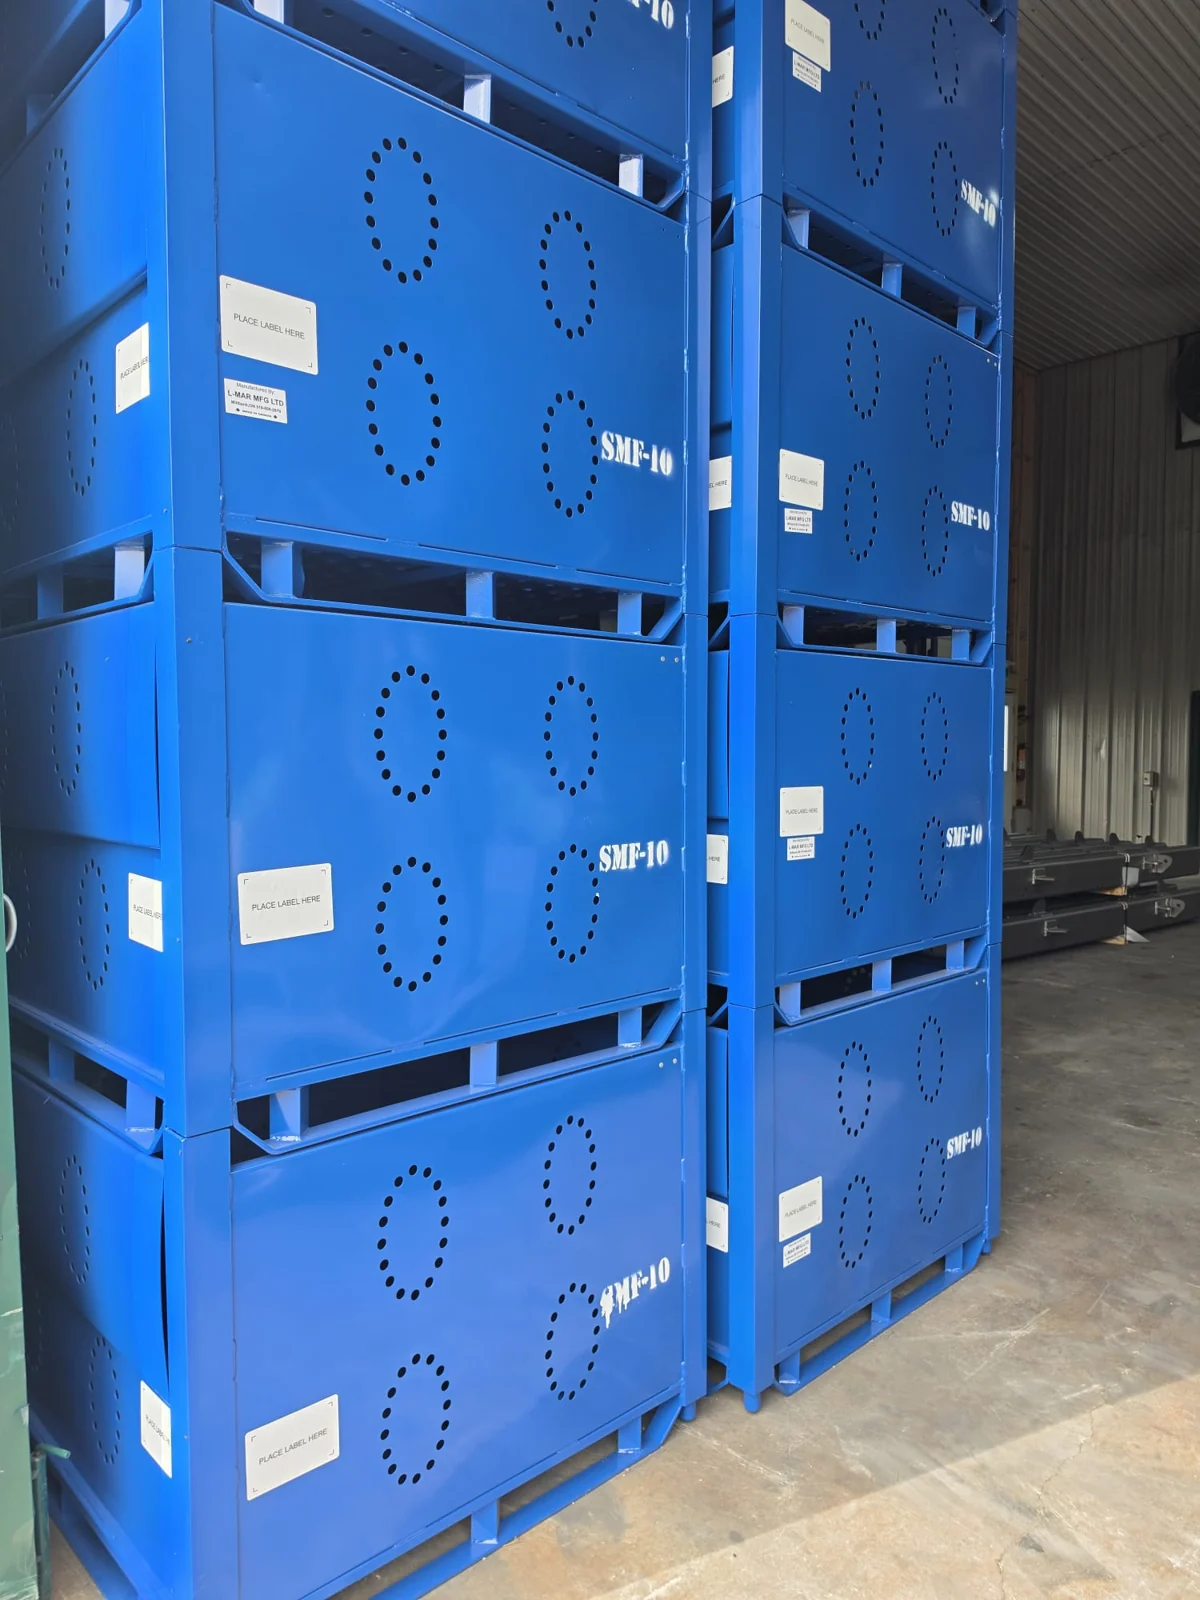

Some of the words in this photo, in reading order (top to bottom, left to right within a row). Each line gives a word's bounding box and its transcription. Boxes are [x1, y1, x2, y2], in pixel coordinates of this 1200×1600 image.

[961, 179, 996, 228] SMF-10
[233, 313, 259, 327] PLACE
[260, 320, 284, 334] LABEL
[284, 327, 305, 340] HERE
[228, 390, 252, 400] L-MAR
[253, 395, 270, 404] MFG
[270, 398, 284, 407] LTD
[601, 430, 673, 476] SMF-10
[951, 500, 990, 531] SMF-10
[946, 824, 982, 848] SMF-10
[599, 840, 669, 872] SMF-10
[251, 901, 276, 911] PLACE
[277, 898, 301, 908] LABEL
[301, 894, 321, 904] HERE
[946, 1126, 982, 1160] SMF-10
[258, 1448, 283, 1466] PLACE
[284, 1438, 307, 1454] LABEL
[308, 1427, 328, 1443] HERE
